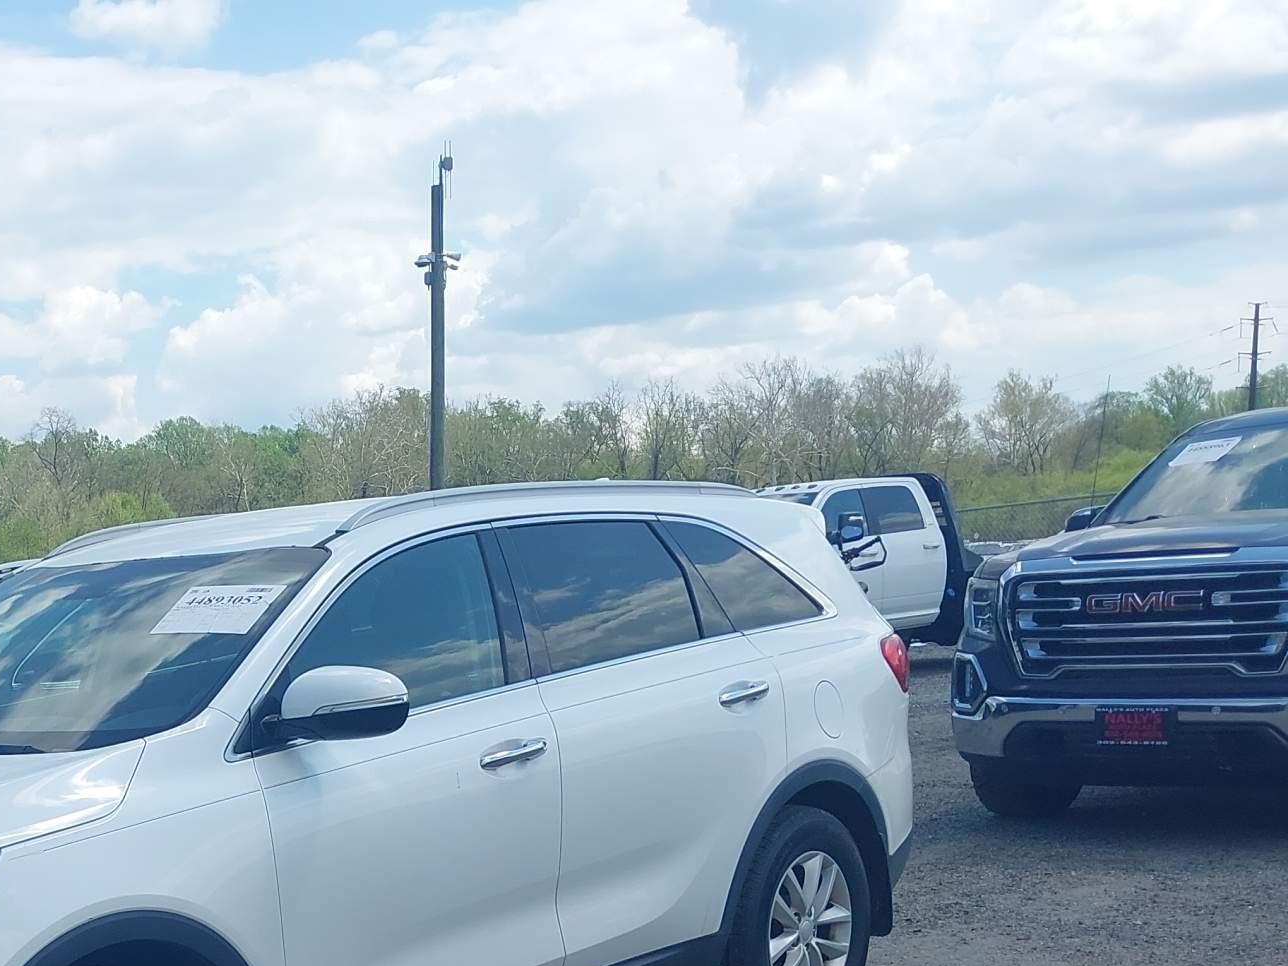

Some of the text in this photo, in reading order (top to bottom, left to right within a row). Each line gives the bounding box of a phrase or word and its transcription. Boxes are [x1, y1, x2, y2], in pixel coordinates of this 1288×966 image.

[185, 595, 263, 606] 44893052
[1086, 590, 1204, 614] GMC
[1104, 713, 1161, 724] NALLY'S
